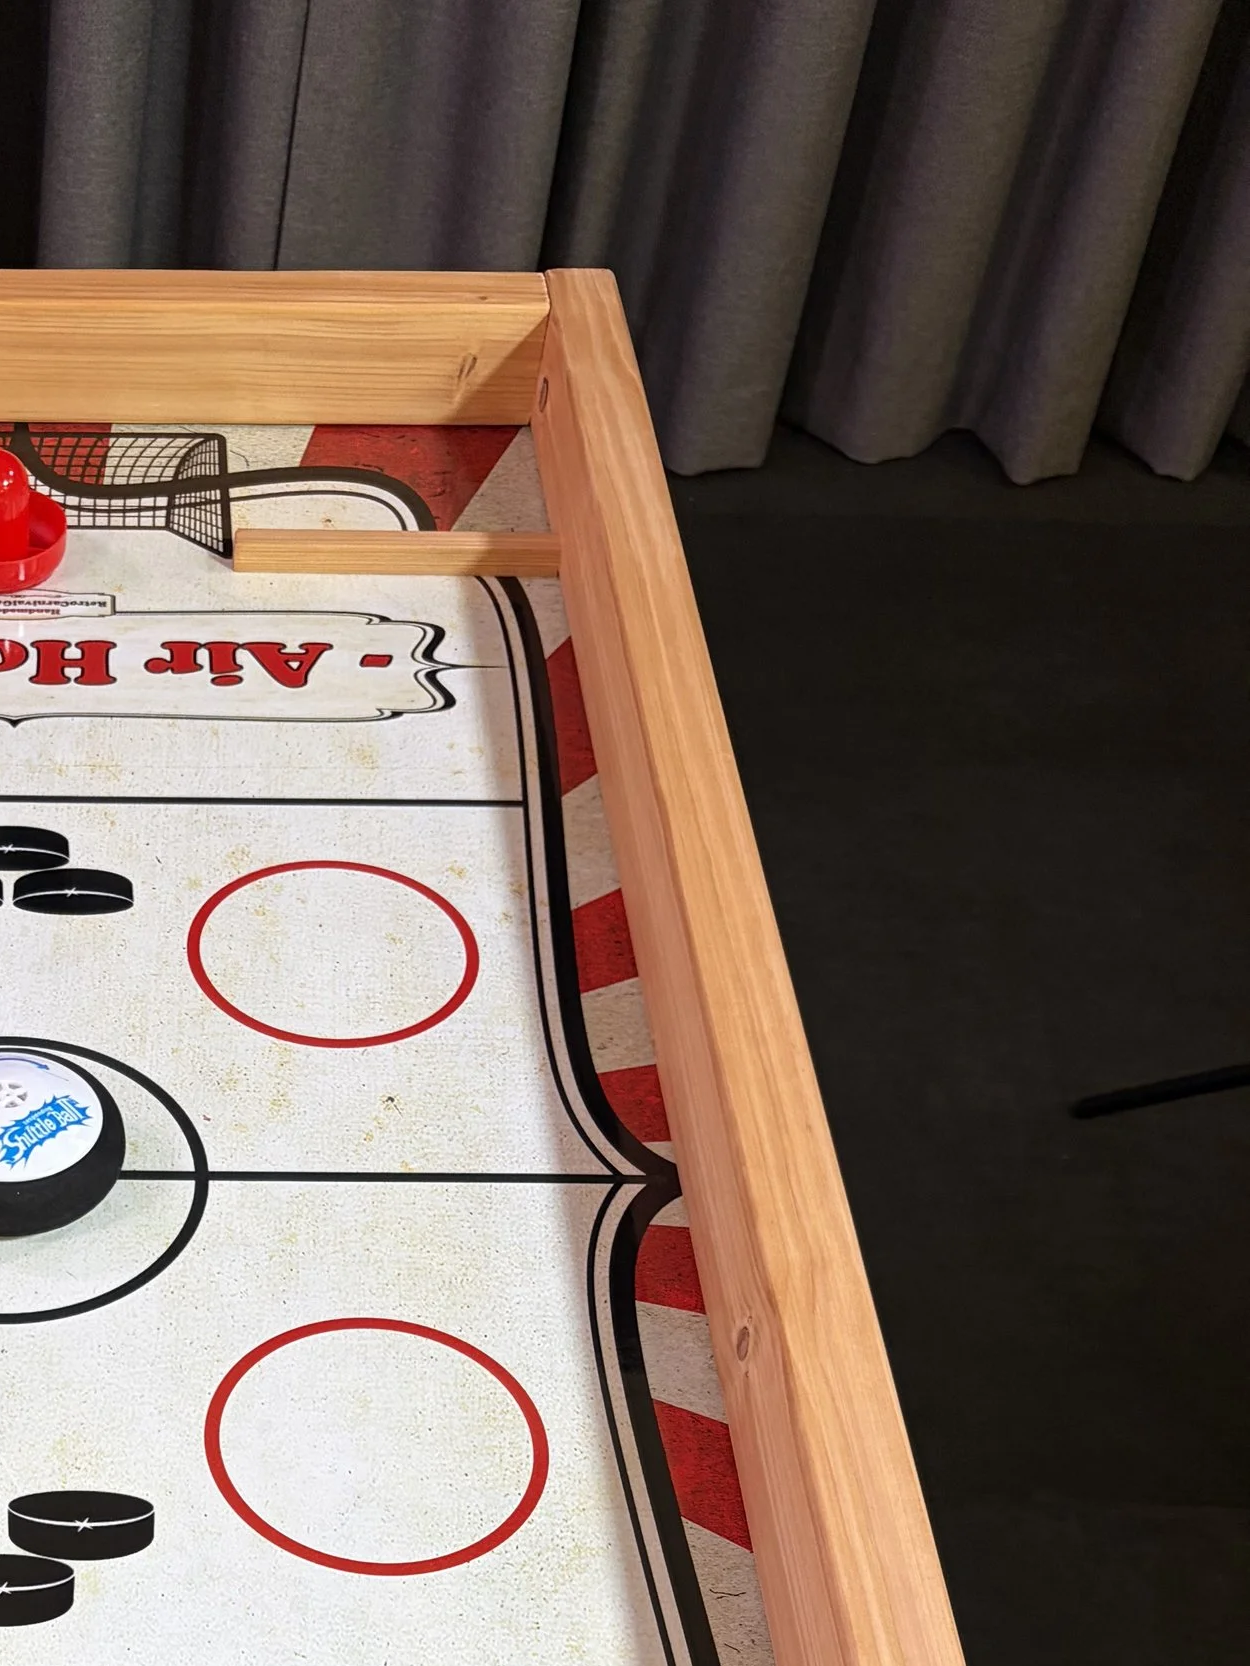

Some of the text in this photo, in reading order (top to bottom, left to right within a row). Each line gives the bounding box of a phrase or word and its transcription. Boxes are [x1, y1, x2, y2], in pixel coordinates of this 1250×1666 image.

[144, 639, 334, 689] Air
[2, 1117, 58, 1164] Shuttle
[47, 1097, 84, 1128] Ball
